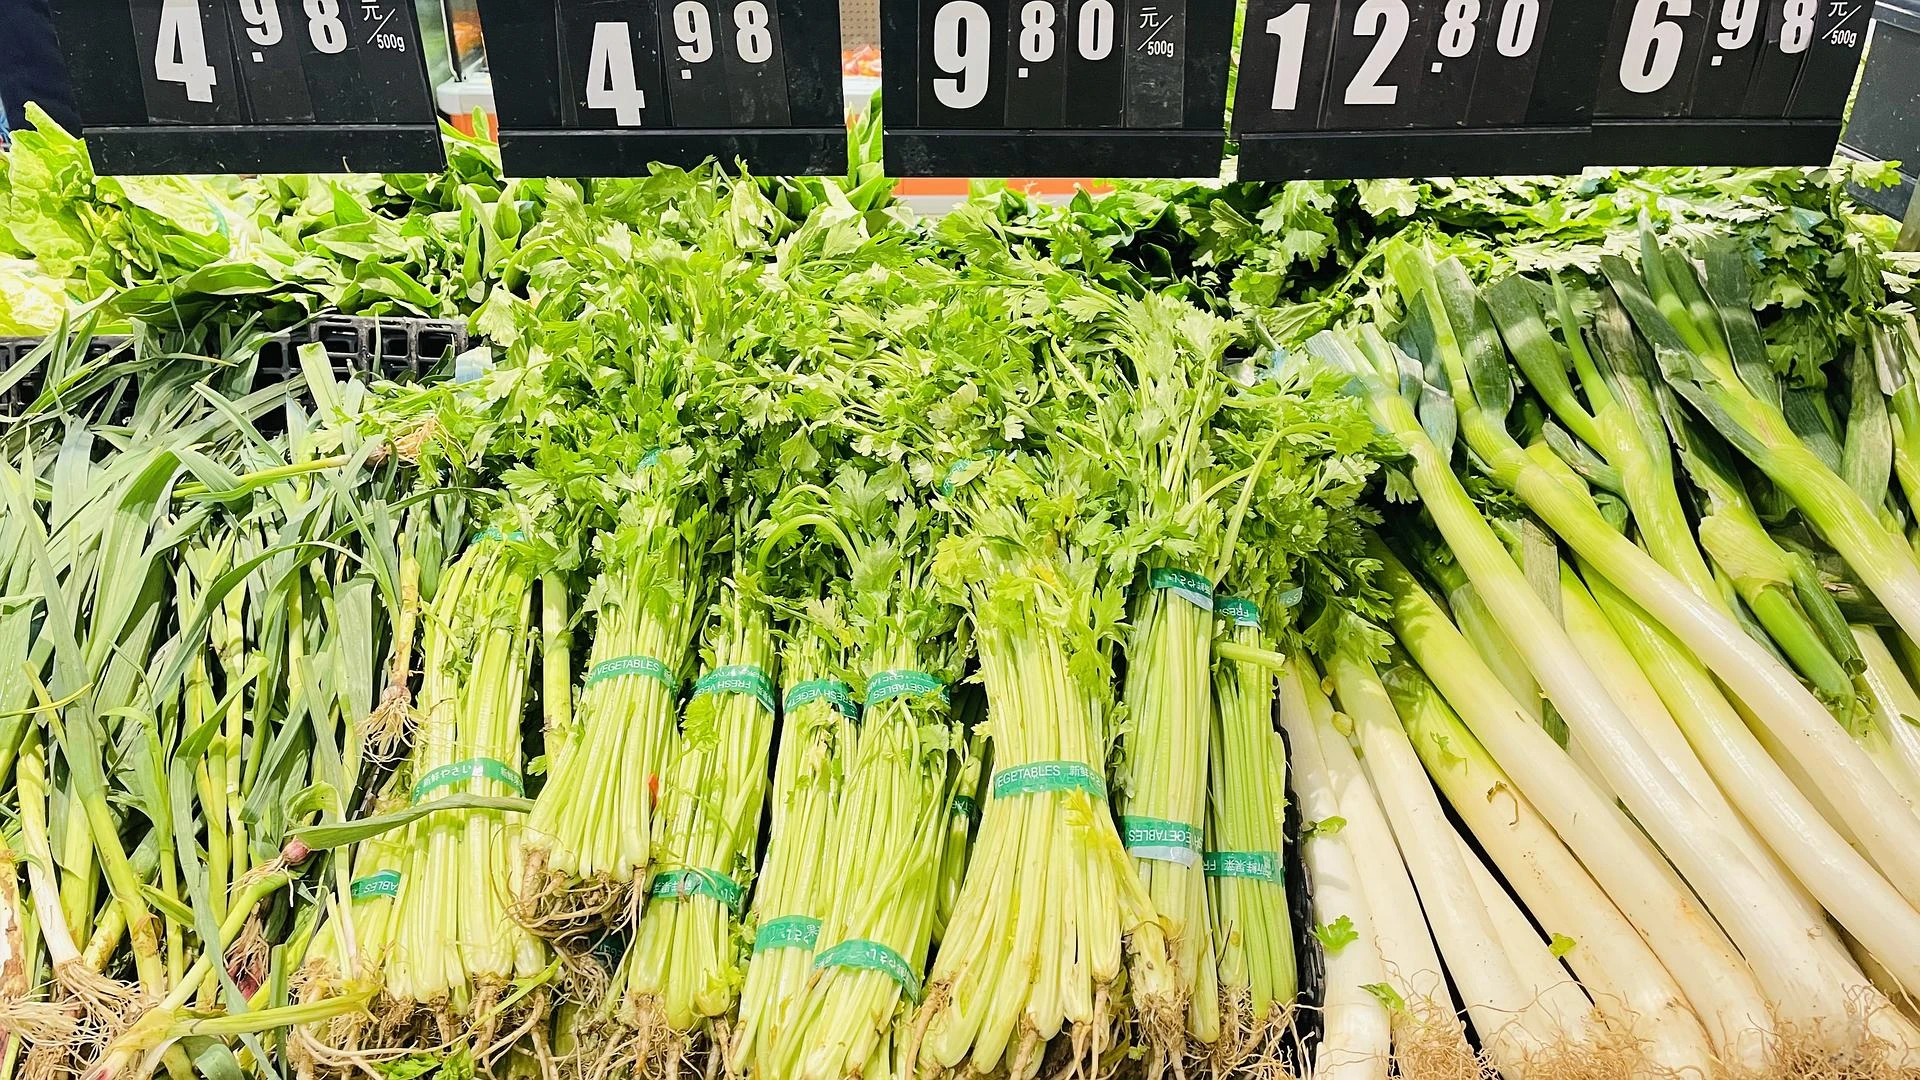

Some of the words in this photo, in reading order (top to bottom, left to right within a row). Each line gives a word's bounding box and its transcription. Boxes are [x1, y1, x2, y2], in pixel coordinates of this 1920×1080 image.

[1221, 606, 1250, 618] FRES
[597, 659, 660, 674] VEGETABLES
[716, 679, 752, 689] FRESH
[996, 764, 1061, 788] EGETABLES
[1128, 828, 1192, 846] EGETABLES
[363, 881, 398, 893] ABLES
